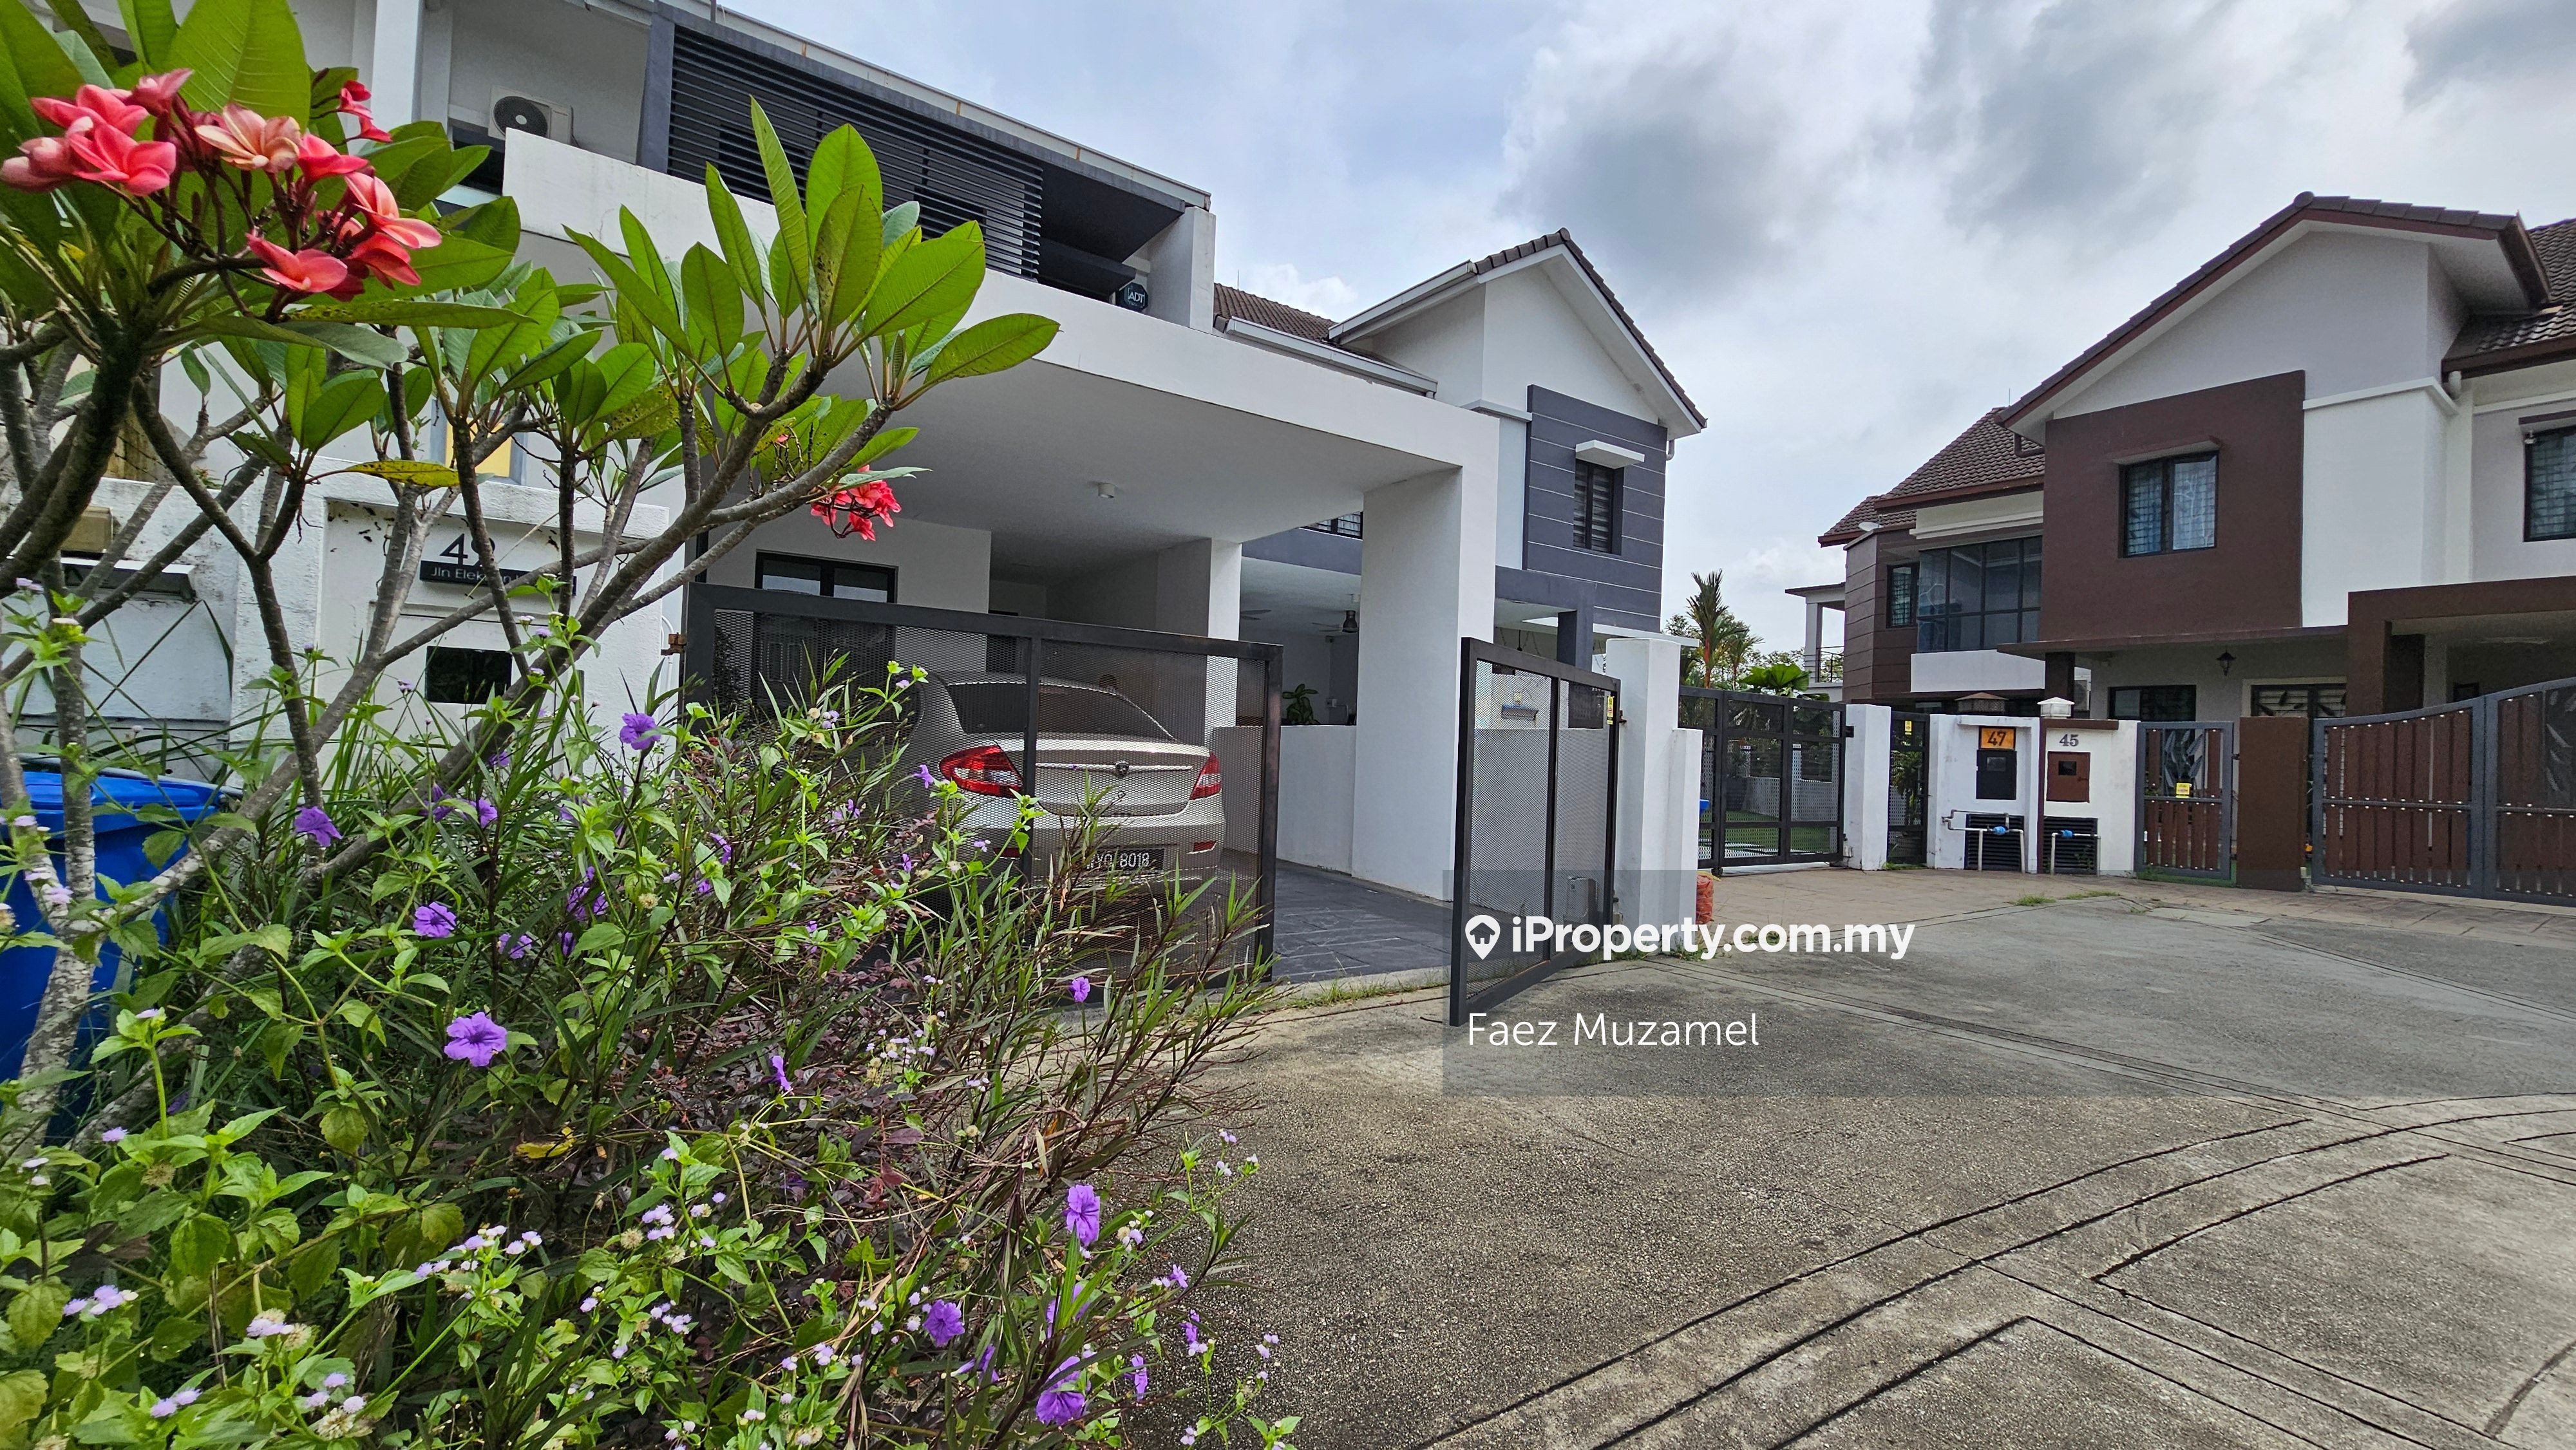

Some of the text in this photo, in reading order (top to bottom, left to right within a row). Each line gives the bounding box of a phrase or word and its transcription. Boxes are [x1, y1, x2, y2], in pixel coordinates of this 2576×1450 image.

[1128, 290, 1144, 303] ADT
[431, 567, 451, 578] Jln
[1987, 731, 2007, 746] 47
[2059, 733, 2079, 747] 45
[1119, 852, 1150, 868] 8018
